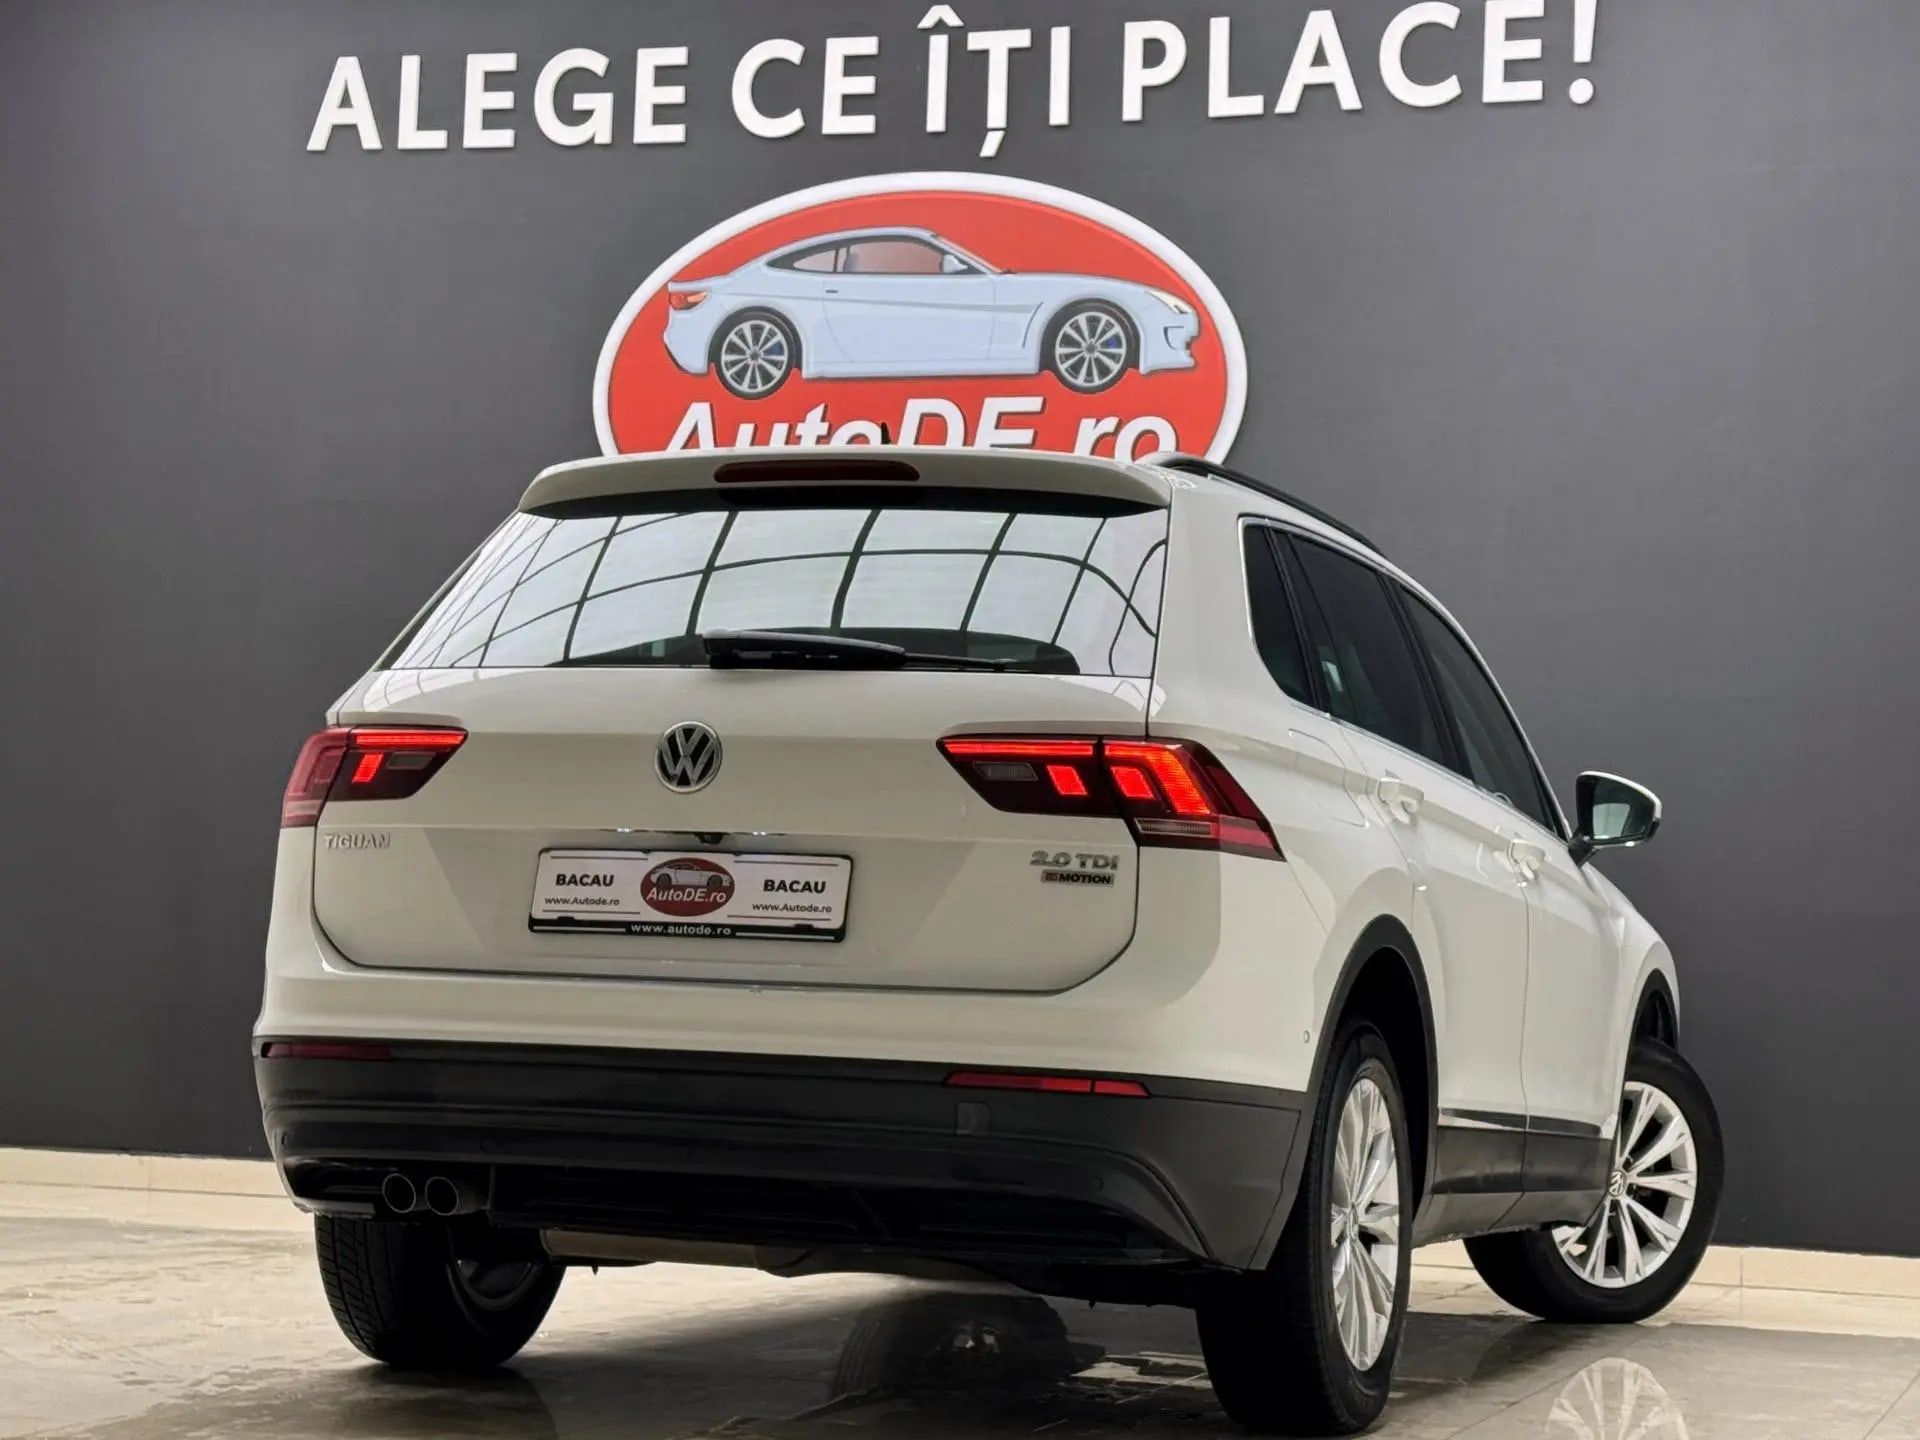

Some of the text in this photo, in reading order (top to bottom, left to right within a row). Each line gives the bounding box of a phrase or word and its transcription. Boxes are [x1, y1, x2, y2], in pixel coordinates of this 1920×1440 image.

[306, 46, 689, 151] ALEGE
[731, 36, 879, 138] CE
[1121, 0, 1597, 122] PLACE!
[323, 832, 391, 849] TIGUAN
[1030, 849, 1120, 870] 2.0 TDI
[555, 873, 615, 888] BACAU
[763, 879, 826, 894] BACAU
[544, 896, 620, 907] www.Autode.ro
[646, 886, 728, 904] AutoDE.ro
[751, 902, 833, 913] www.Autode.ro
[630, 922, 732, 937] www.autode.ro
